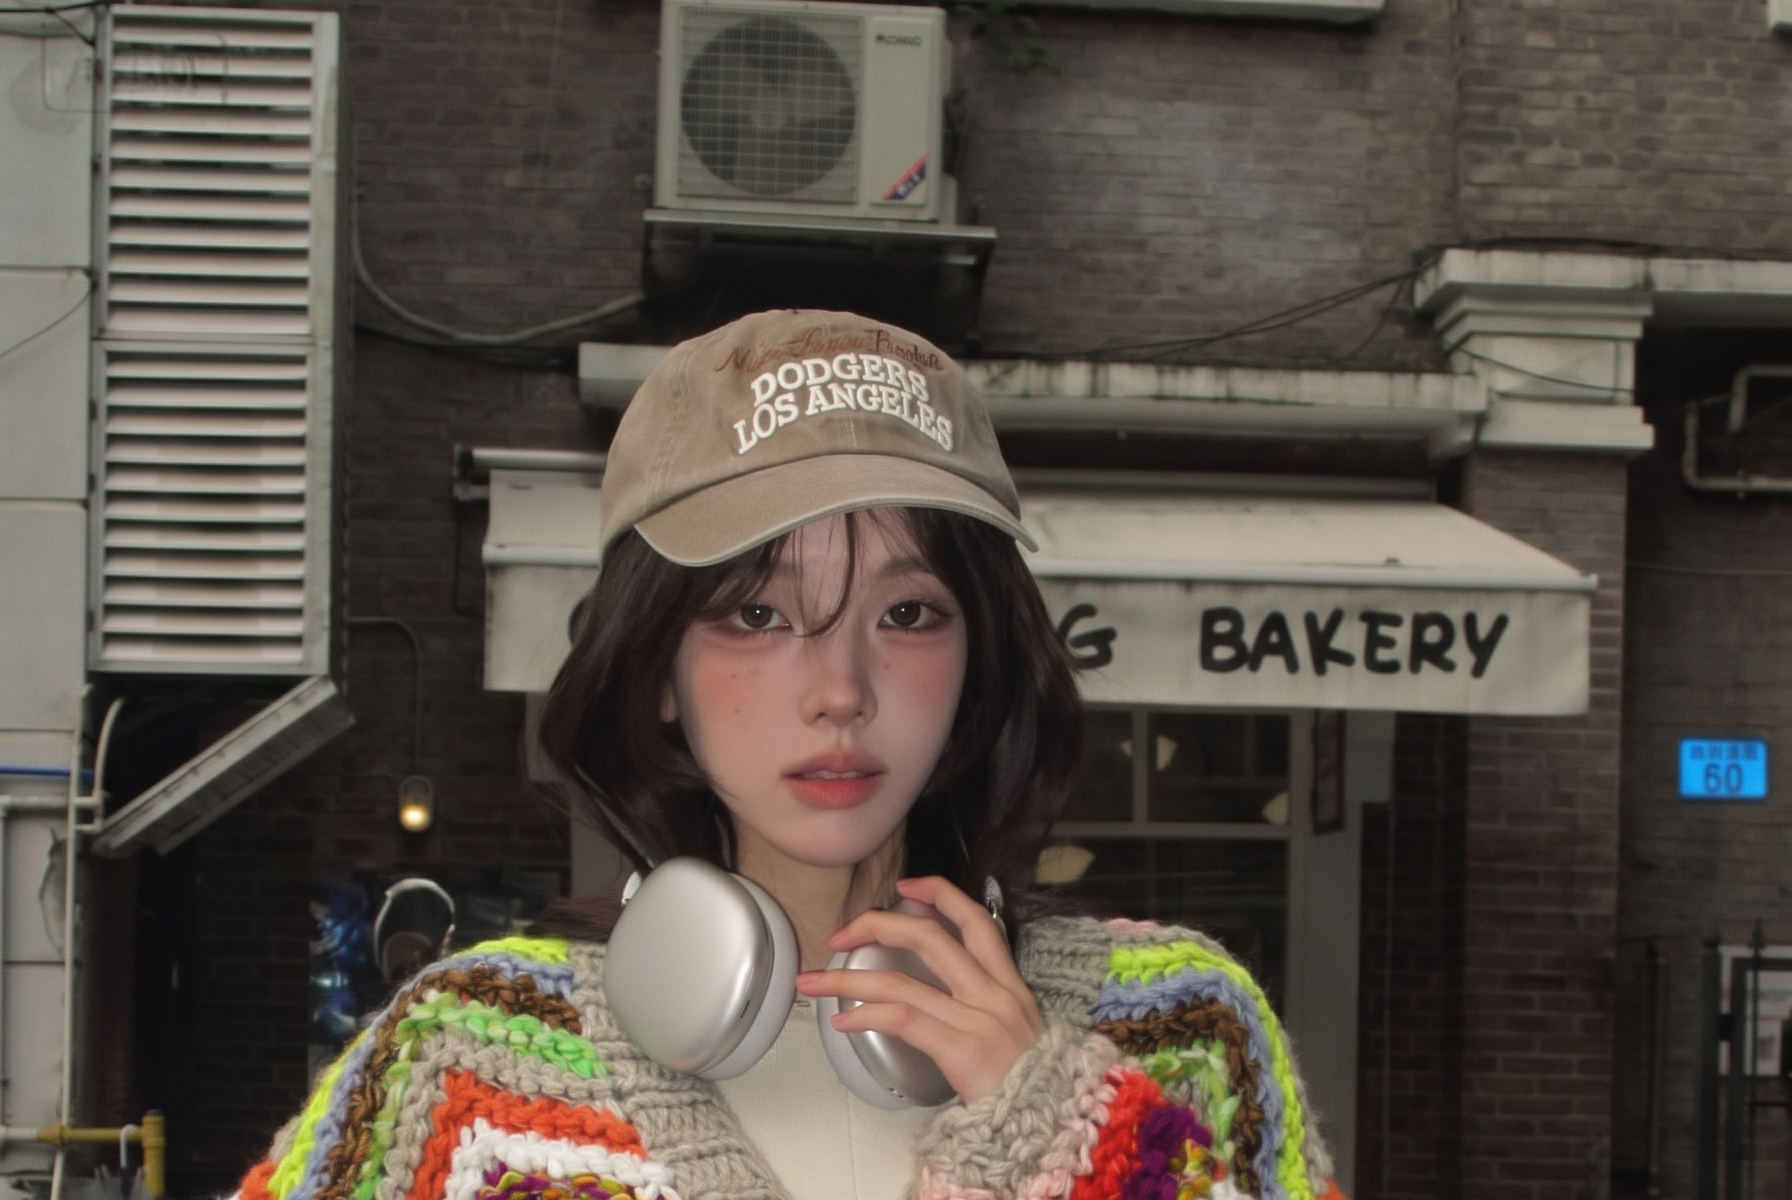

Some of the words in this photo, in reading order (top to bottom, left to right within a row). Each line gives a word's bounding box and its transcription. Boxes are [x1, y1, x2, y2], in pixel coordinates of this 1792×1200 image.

[751, 353, 930, 408] DODGERS
[733, 392, 799, 454] LOS
[805, 383, 953, 451] ANGELES
[1200, 606, 1509, 678] BAKERY
[1704, 763, 1743, 797] 60
